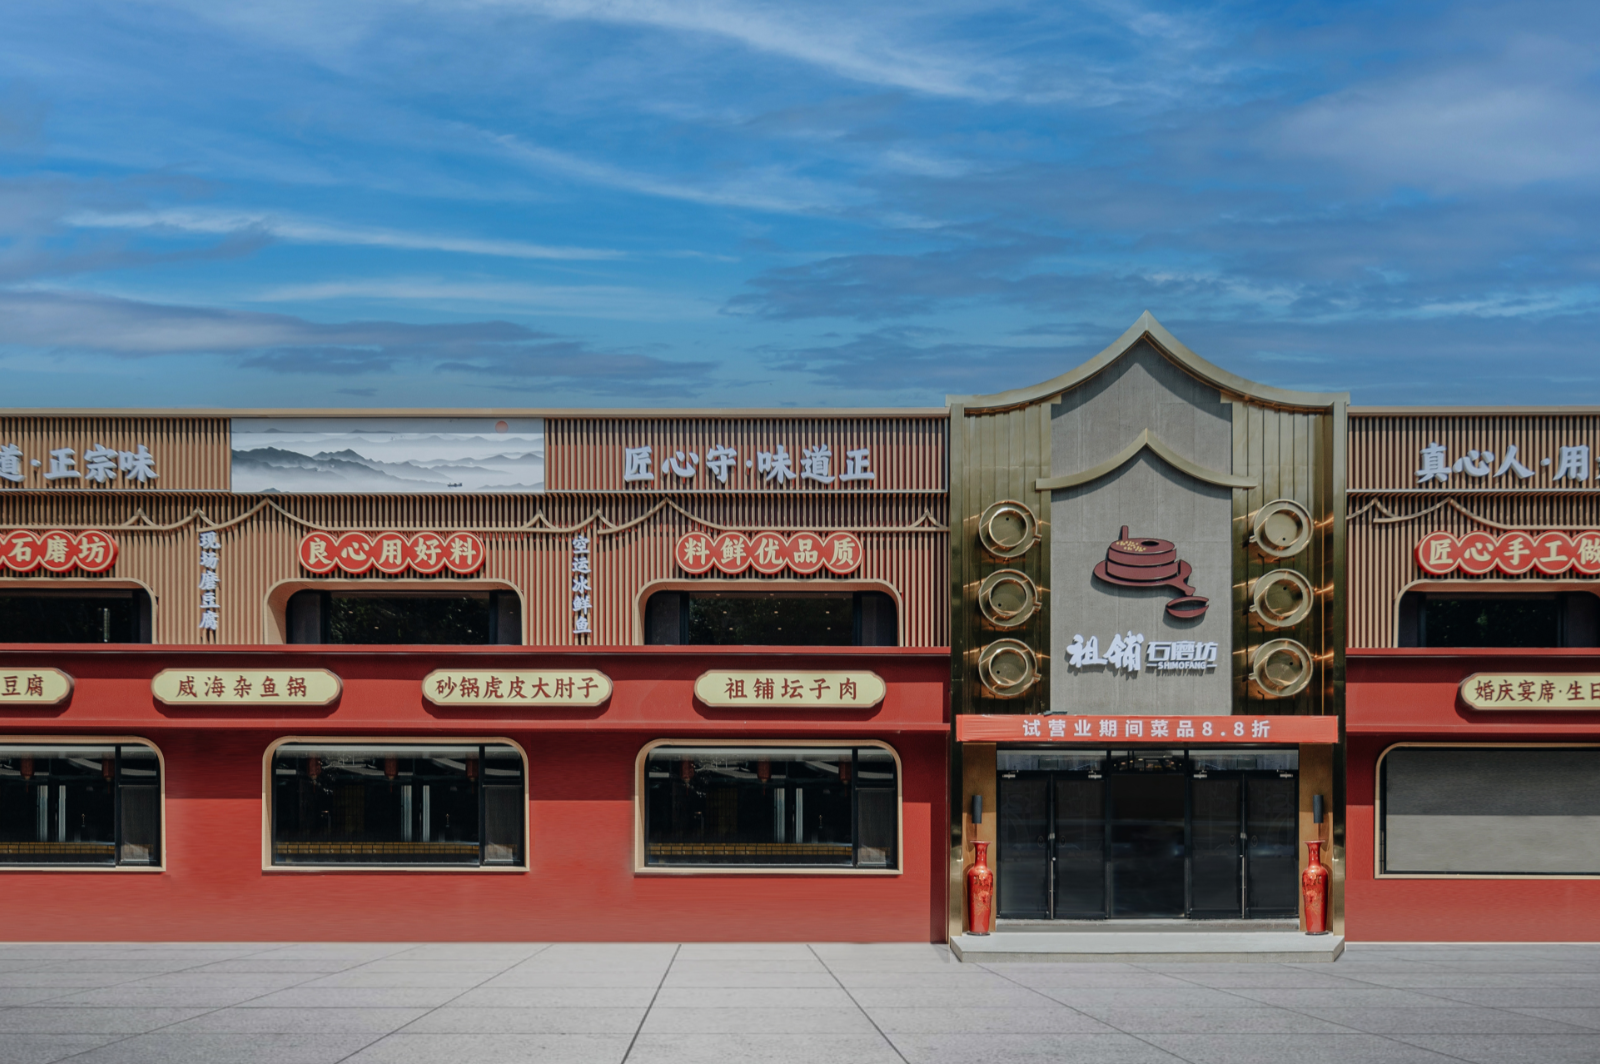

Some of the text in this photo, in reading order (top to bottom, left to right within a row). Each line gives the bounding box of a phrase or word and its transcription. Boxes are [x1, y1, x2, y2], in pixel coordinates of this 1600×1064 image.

[624, 444, 875, 484] 匠心守·味道正
[1414, 441, 1600, 483] 真心人·用
[7, 535, 107, 564] 石磨坊
[308, 536, 477, 566] 良心用好料
[683, 536, 856, 566] 料鲜优品质
[199, 530, 221, 630] 现场磨豆腐
[572, 535, 592, 634] 空运冰鲜鱼
[1146, 640, 1219, 662] 石磨坊
[1157, 661, 1207, 670] SHIMOFANG
[1, 673, 44, 697] 豆腐
[176, 675, 307, 699] 威海杂鱼锅
[435, 675, 599, 699] 砂锅虎皮大肘子
[724, 677, 858, 700] 祖铺坛子肉
[1022, 719, 1271, 739] 试营业期间菜品8.8折
